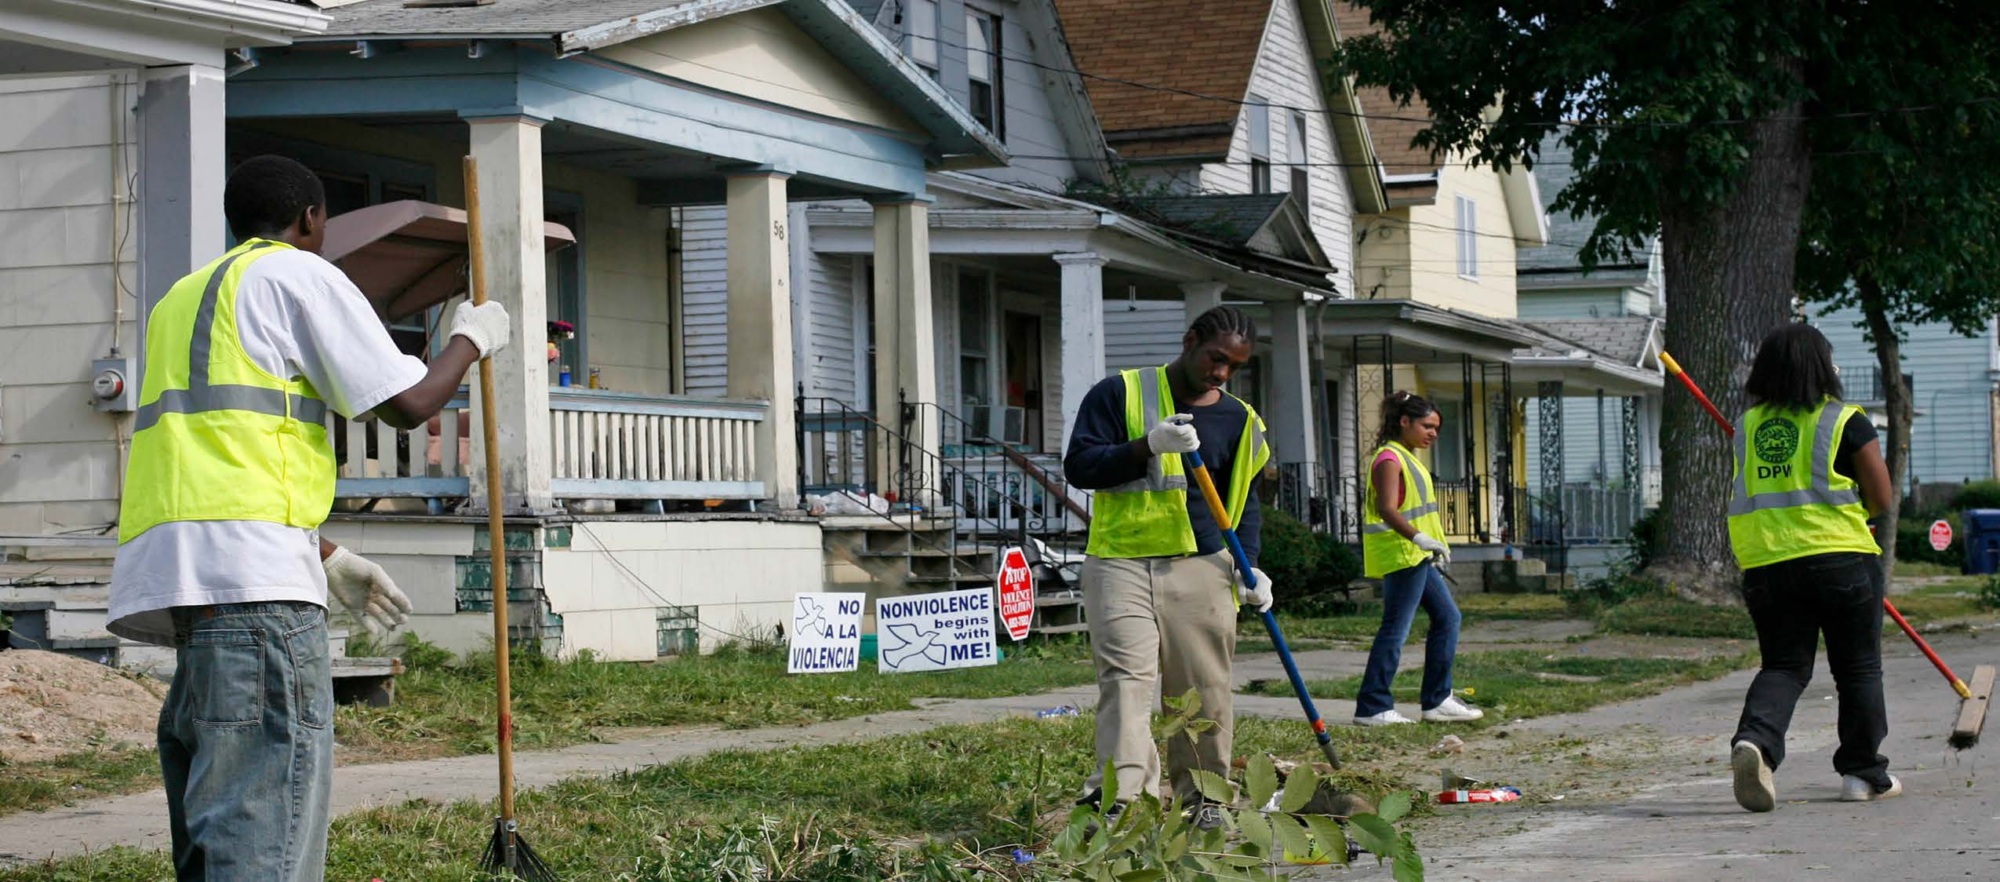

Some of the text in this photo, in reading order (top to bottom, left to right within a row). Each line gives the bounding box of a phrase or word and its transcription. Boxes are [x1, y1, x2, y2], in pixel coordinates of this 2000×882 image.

[774, 220, 785, 240] 58
[1005, 567, 1027, 585] STOP
[1002, 589, 1031, 604] VIOLENCE
[838, 600, 860, 615] NO
[880, 594, 989, 619] NONVIOLENCE
[1003, 601, 1031, 615] COALITION
[934, 616, 989, 629] begins
[824, 624, 857, 639] A LA
[954, 628, 989, 640] with
[793, 647, 855, 669] VIOLENCIA
[950, 642, 991, 661] ME!
